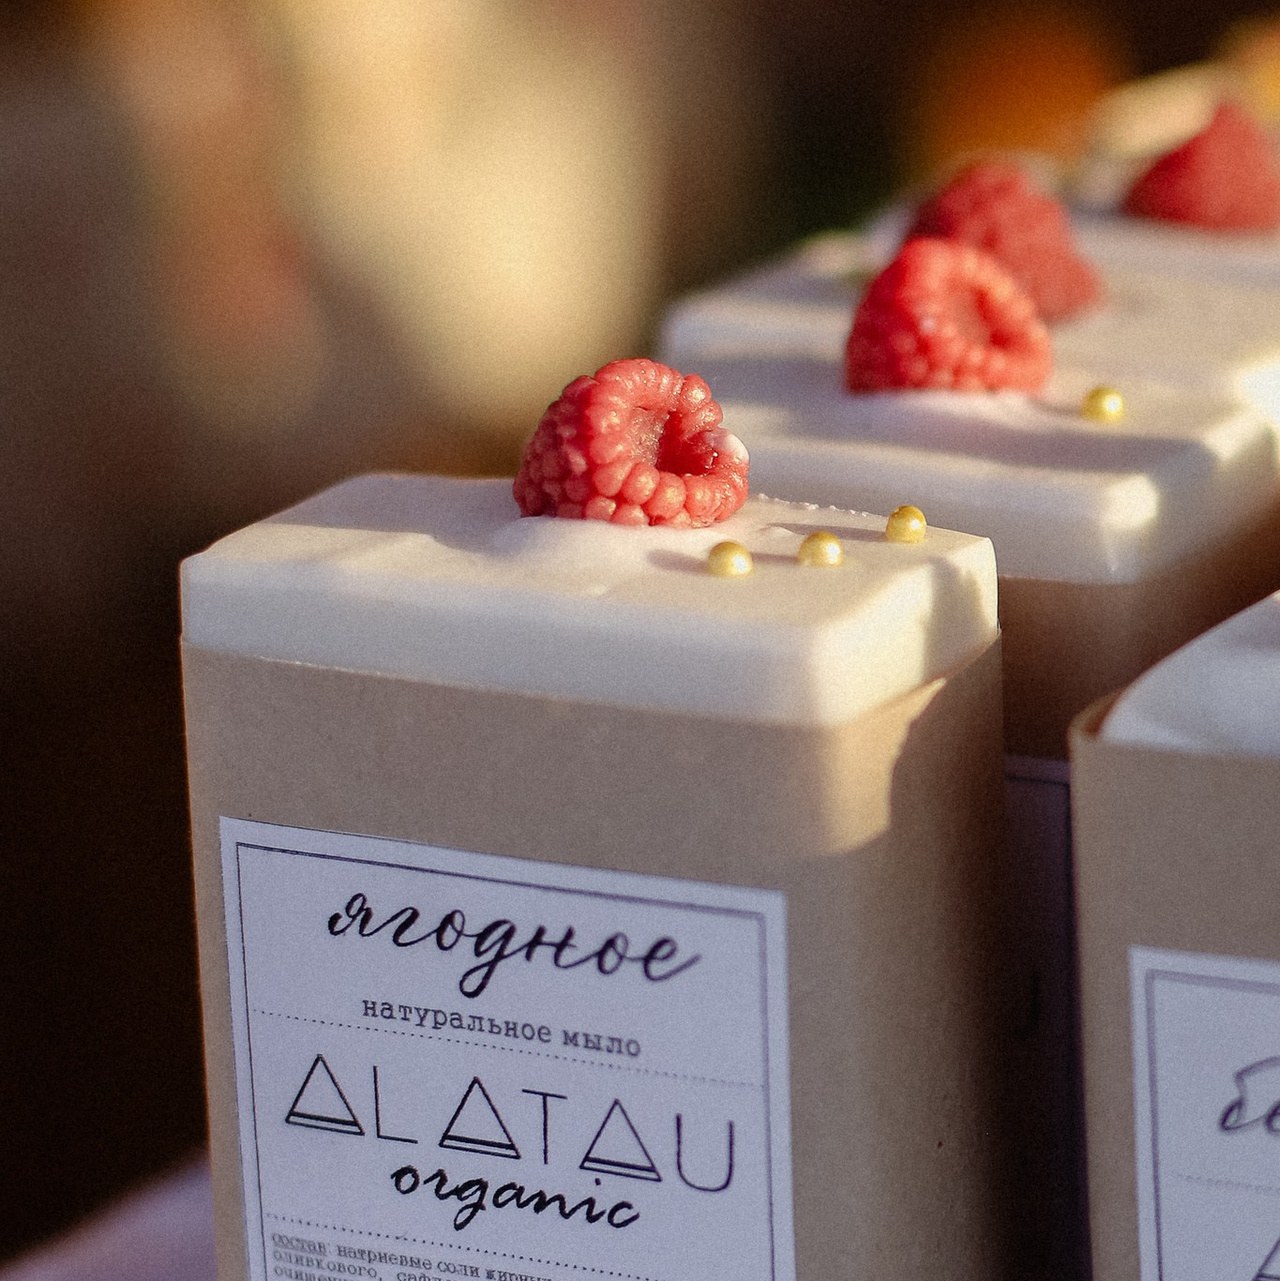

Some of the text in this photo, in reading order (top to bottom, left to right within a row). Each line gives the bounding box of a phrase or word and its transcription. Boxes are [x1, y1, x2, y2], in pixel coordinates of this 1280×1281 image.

[327, 892, 700, 998] ягодное
[362, 998, 642, 1058] натуральное мыло
[285, 1053, 735, 1193] ALATAU
[390, 1164, 640, 1231] organic
[273, 1250, 384, 1281] оливкового,
[336, 1244, 433, 1271] натриевые
[436, 1261, 481, 1278] соли
